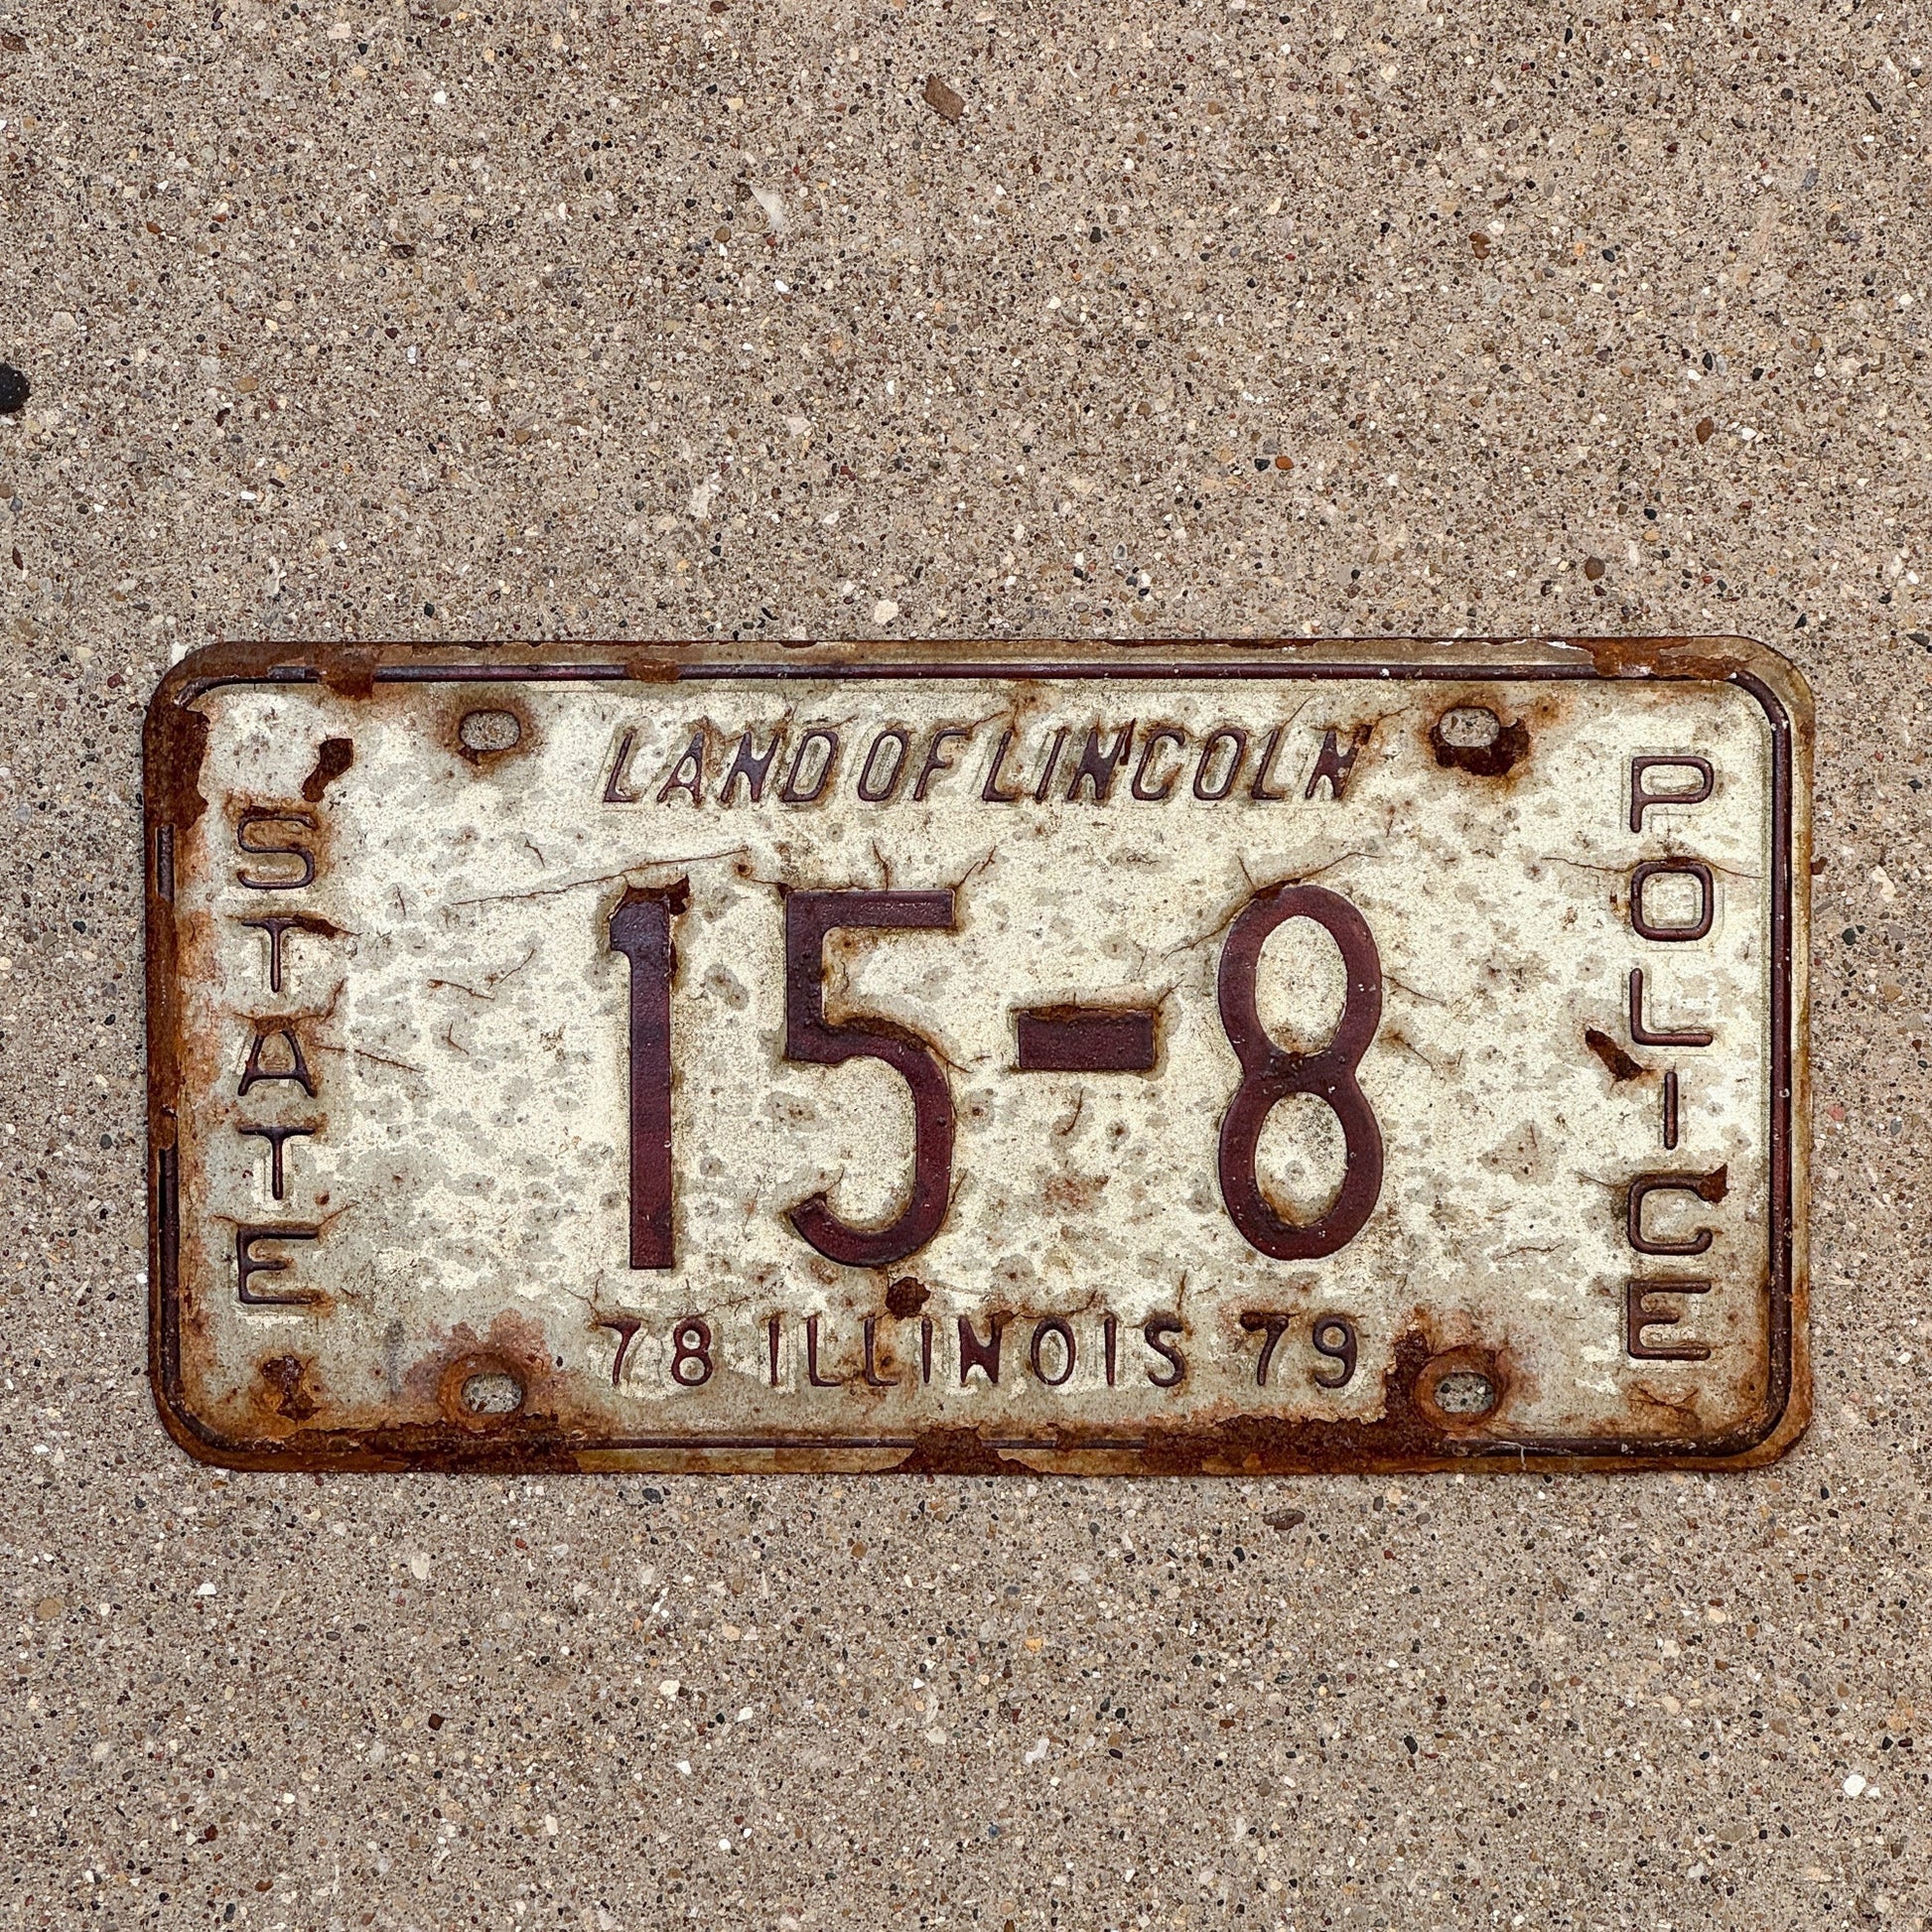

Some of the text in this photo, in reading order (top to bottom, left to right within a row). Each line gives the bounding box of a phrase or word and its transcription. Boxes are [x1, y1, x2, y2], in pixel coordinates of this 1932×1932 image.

[603, 726, 1362, 806] LAND OF LINCOLN
[237, 813, 321, 1305] STATE
[610, 883, 1384, 1270] 15-8
[1627, 756, 1716, 1361] POLICE
[598, 1312, 1358, 1389] 78 ILLINOIS 79
